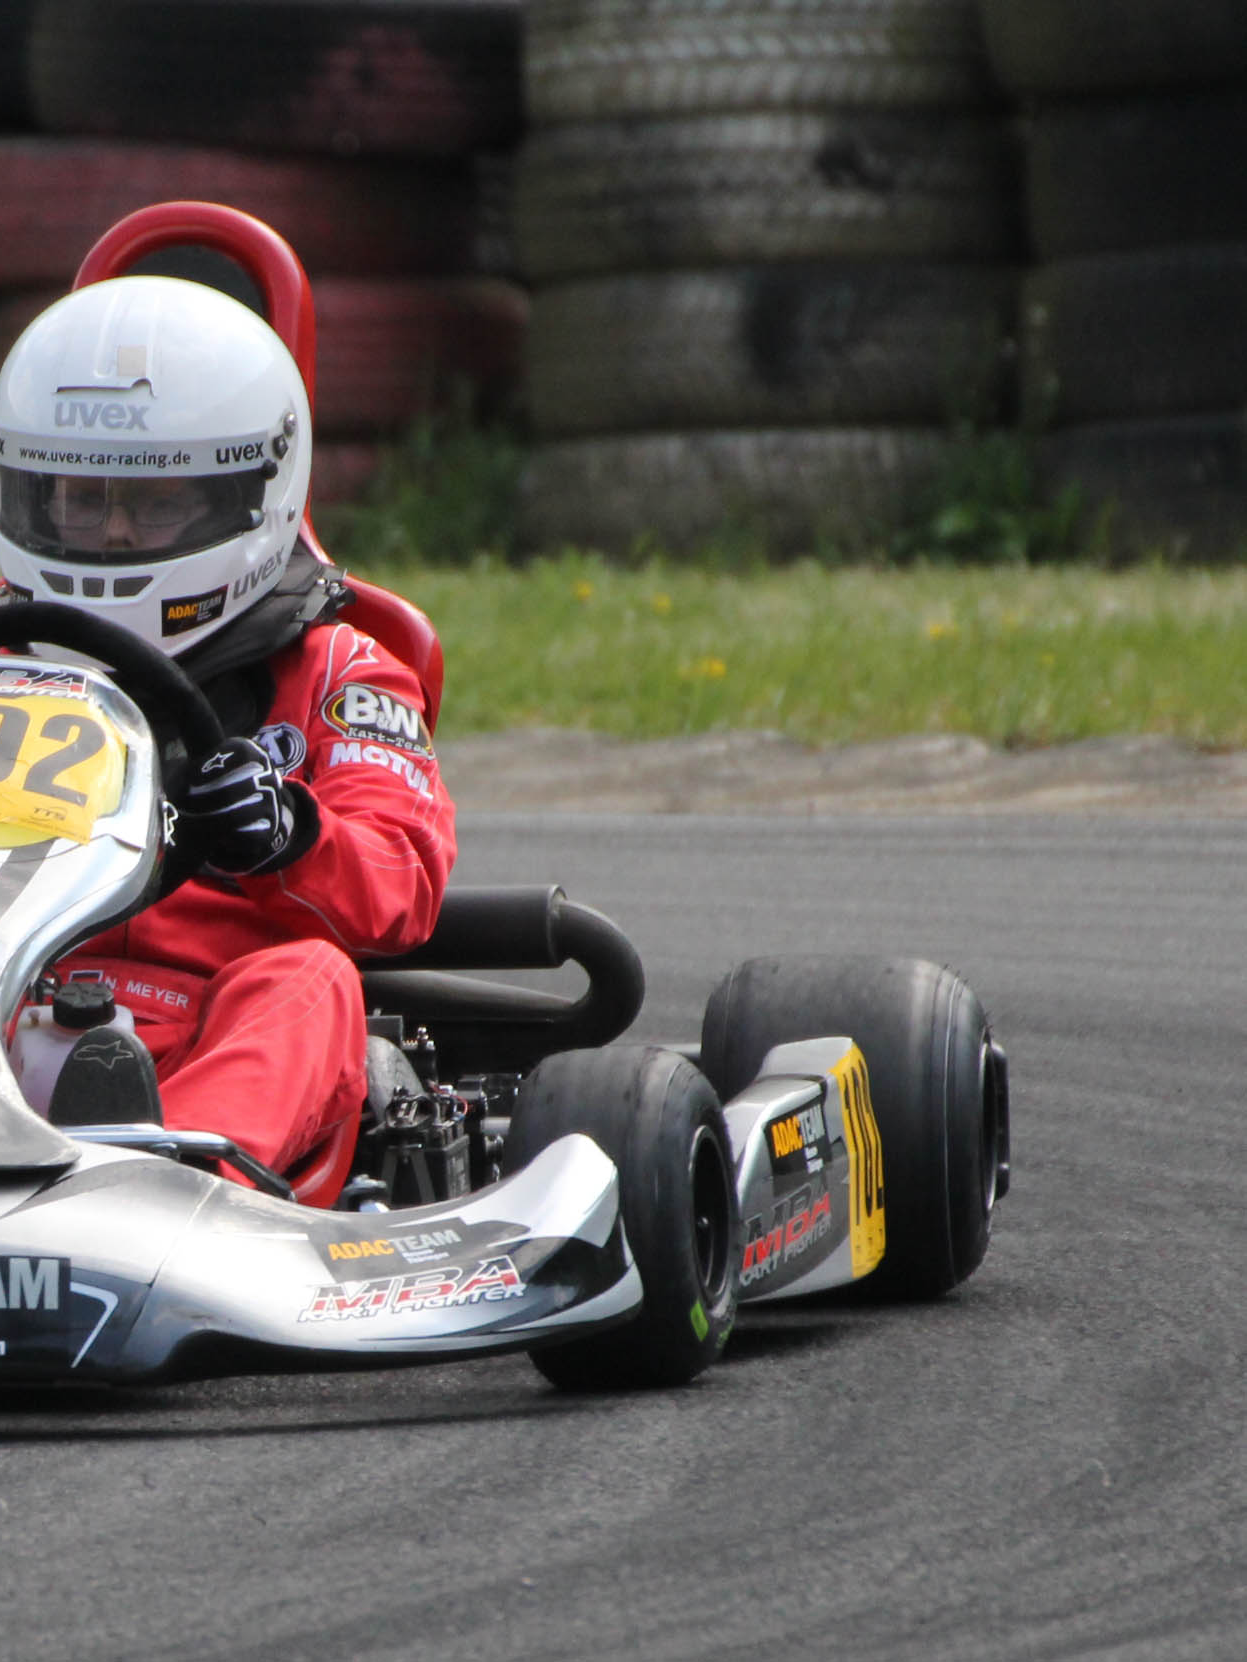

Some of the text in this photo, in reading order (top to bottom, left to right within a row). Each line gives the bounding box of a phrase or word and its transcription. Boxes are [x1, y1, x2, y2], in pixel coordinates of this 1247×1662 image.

[54, 401, 149, 430] uvex
[19, 446, 191, 469] www.uvex-car-racing.de
[215, 440, 265, 465] uvex
[233, 545, 284, 601] uvex
[329, 741, 434, 800] MOTUL
[126, 980, 189, 1008] MEYER
